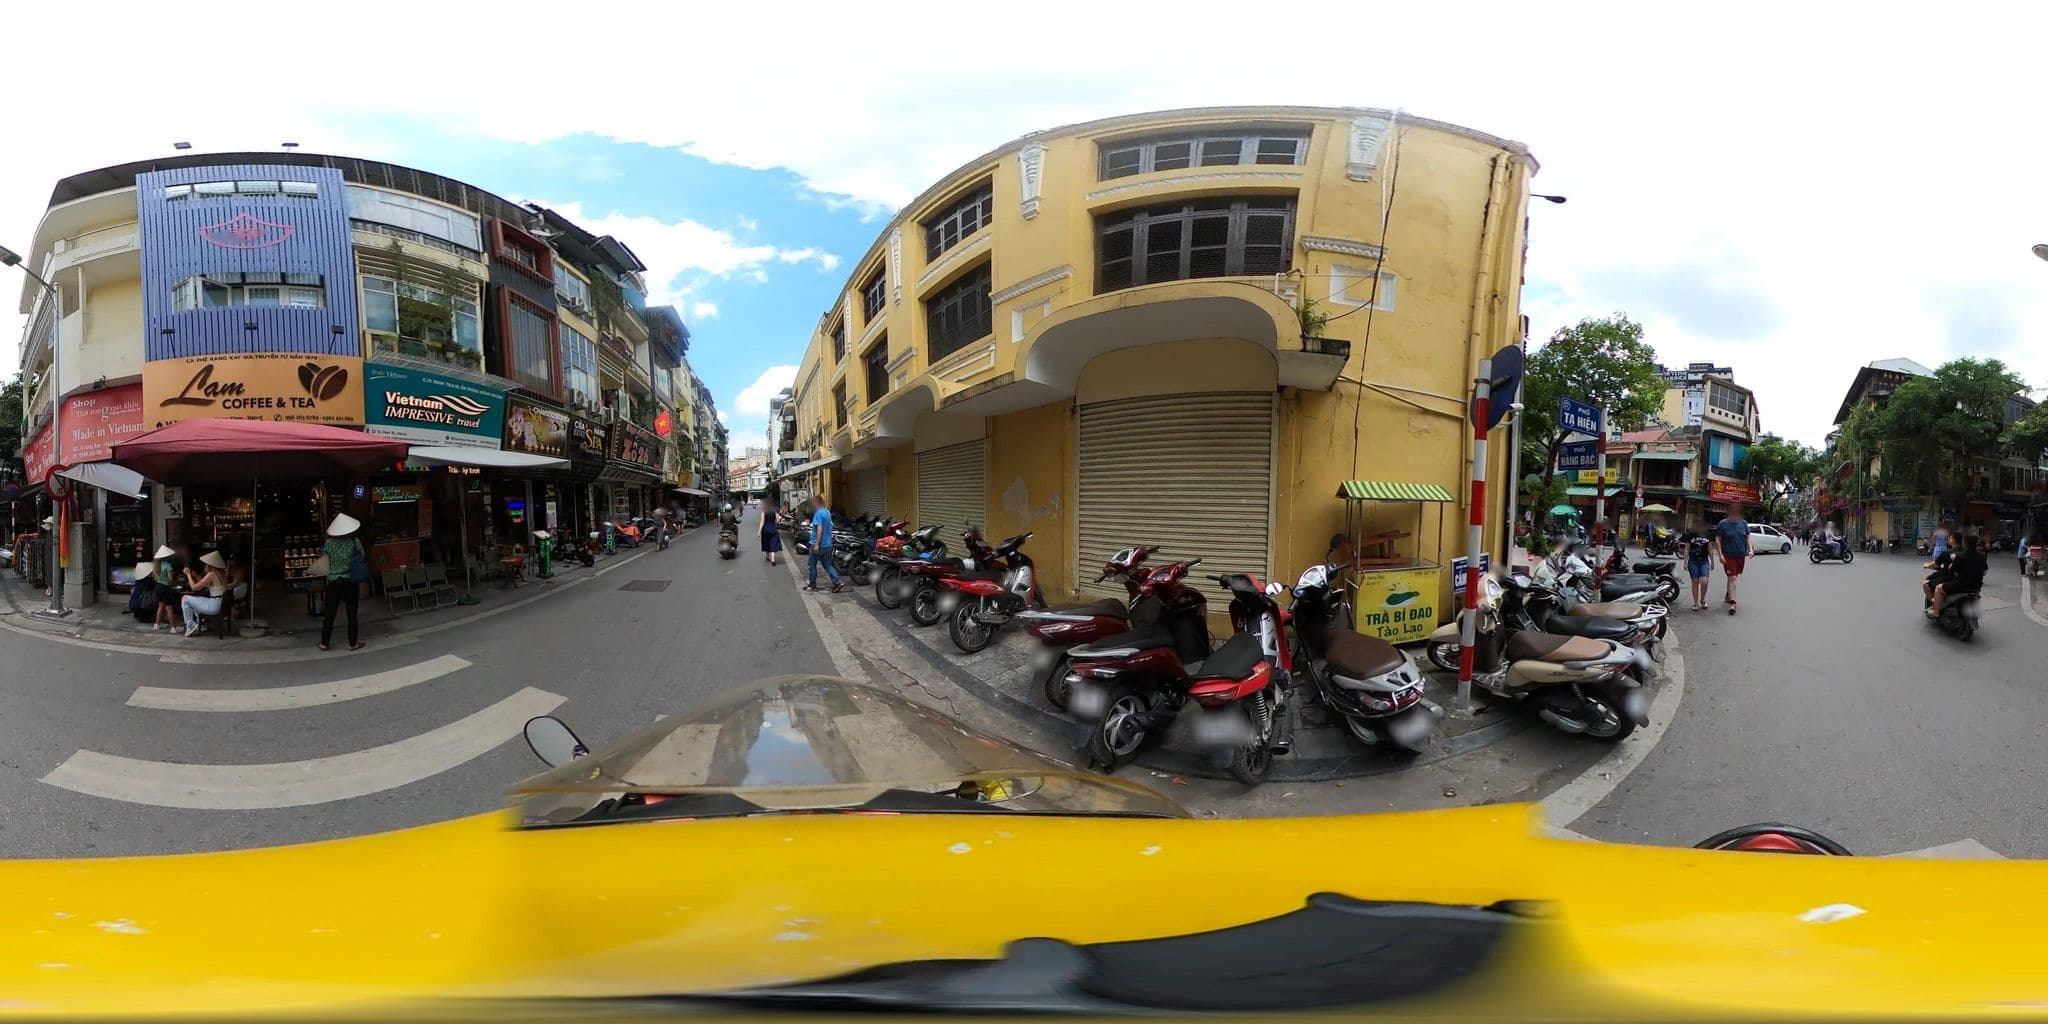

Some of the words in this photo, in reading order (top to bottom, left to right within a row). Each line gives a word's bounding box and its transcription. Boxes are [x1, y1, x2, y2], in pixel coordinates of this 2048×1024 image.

[159, 363, 245, 408] Lam
[72, 399, 96, 408] Shop
[221, 397, 273, 410] COFFEE
[275, 397, 286, 409] &
[291, 396, 316, 409] TEA
[385, 391, 443, 411] Vietnam
[385, 406, 454, 424] IMPRESSIVE
[456, 417, 480, 428] travel
[1578, 407, 1591, 416] PHỐ
[1564, 412, 1576, 427] TẠ
[1577, 416, 1597, 432] HIỆN
[73, 427, 95, 441] Made
[97, 426, 106, 437] in
[1561, 454, 1579, 466] HÀNG
[1365, 611, 1391, 626] TRÀ
[1394, 608, 1406, 621] BÍ
[1409, 606, 1433, 620] ĐAO
[1377, 626, 1399, 638] Tào
[1403, 622, 1423, 634] Lao
